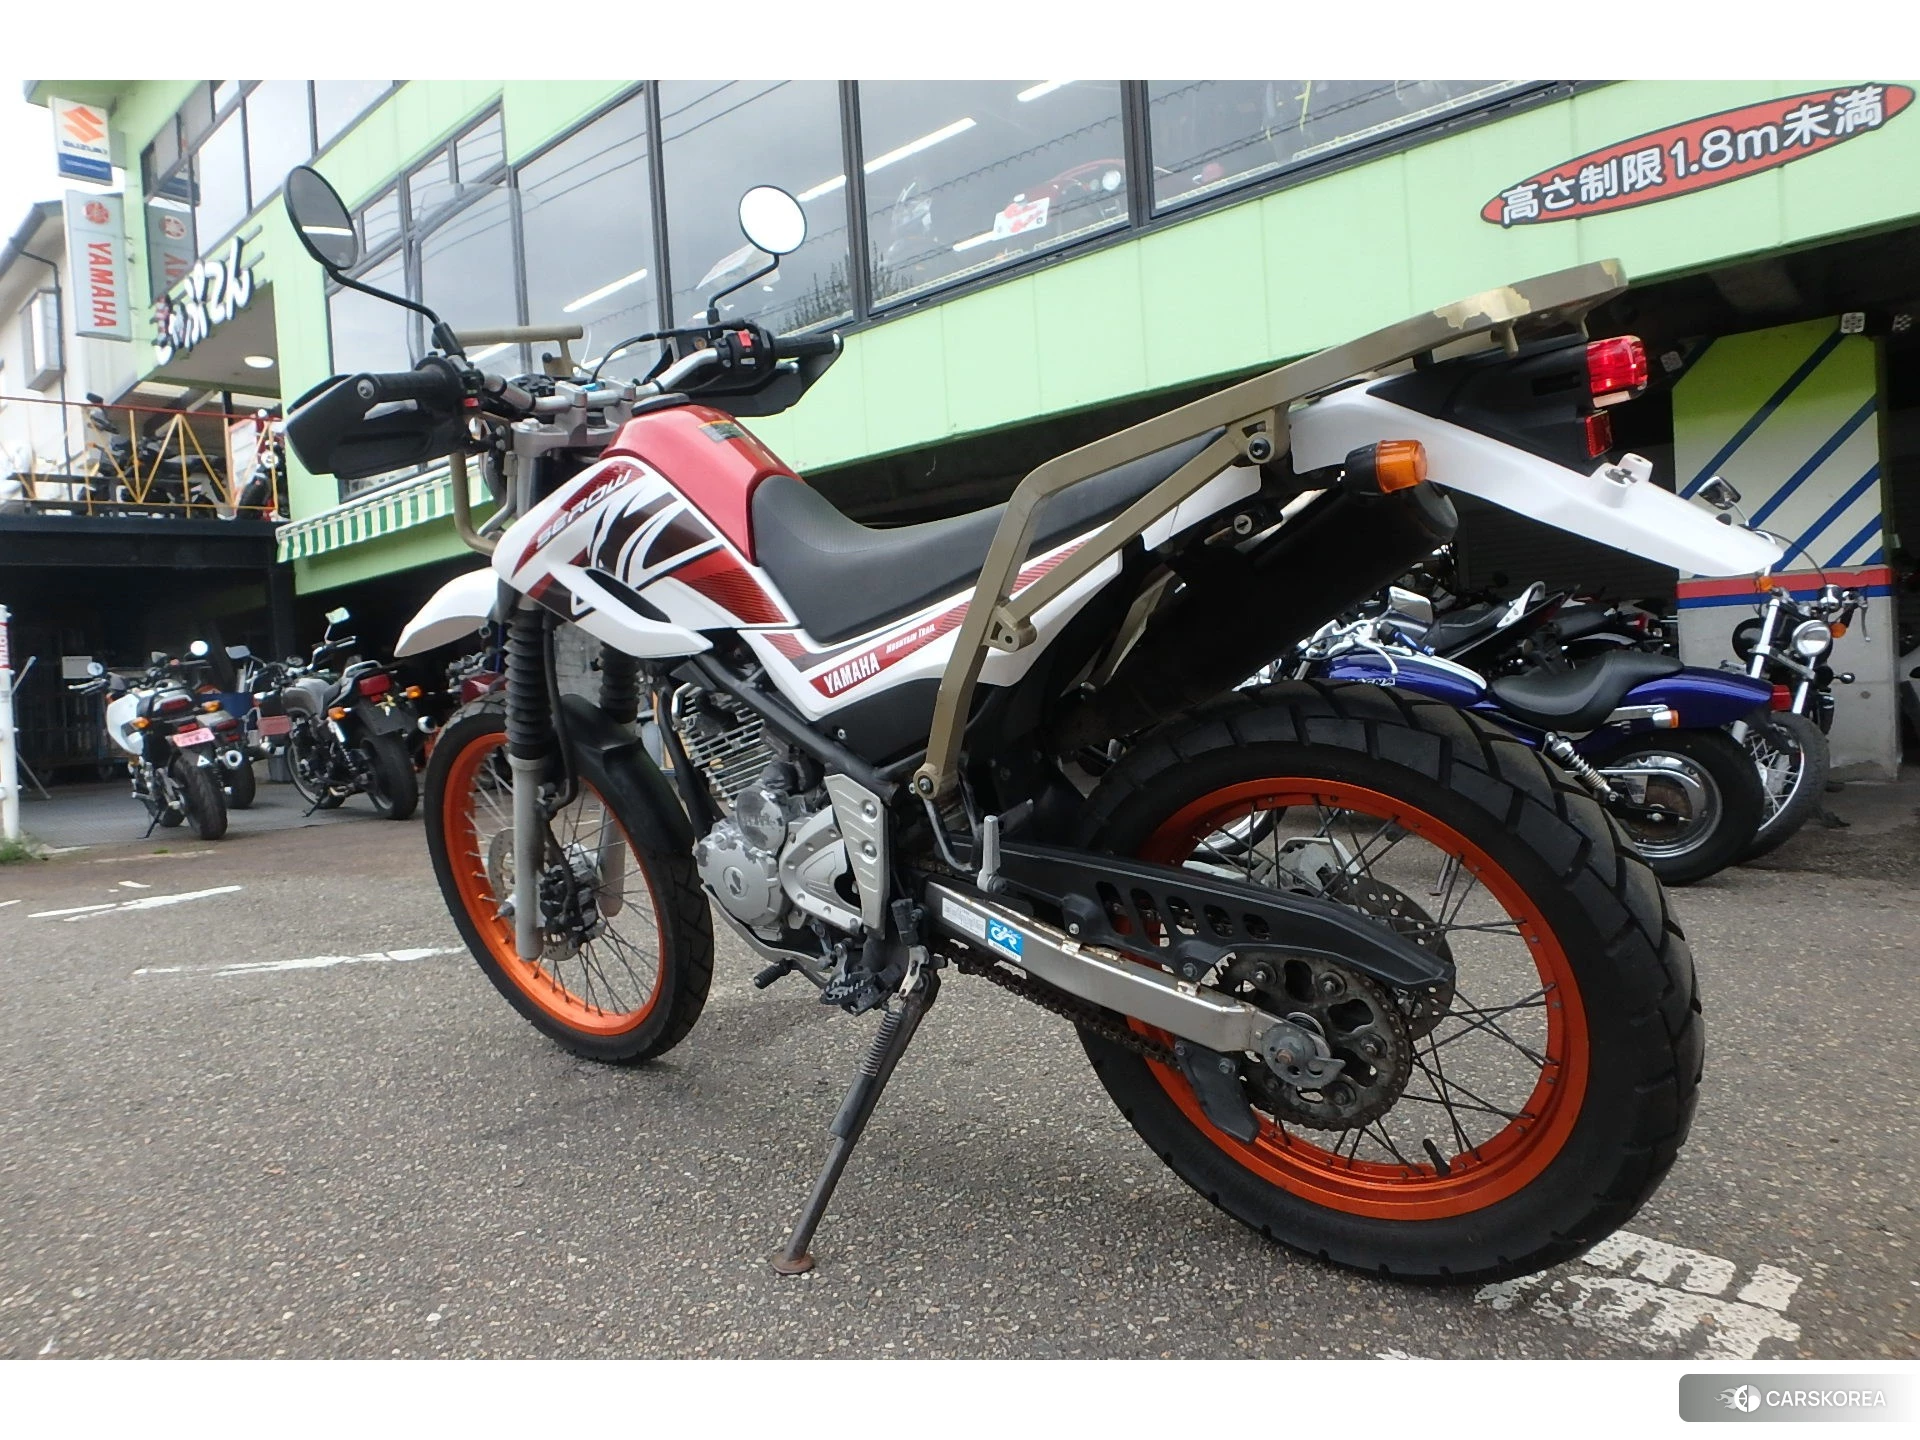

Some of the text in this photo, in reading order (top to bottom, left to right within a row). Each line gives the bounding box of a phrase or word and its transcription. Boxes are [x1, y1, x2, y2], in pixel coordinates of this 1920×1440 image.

[1501, 85, 1884, 225] 高さ制限1.8m未満
[87, 241, 117, 328] YAMAHA
[536, 468, 632, 550] SEROW
[823, 652, 881, 694] YAMAHA
